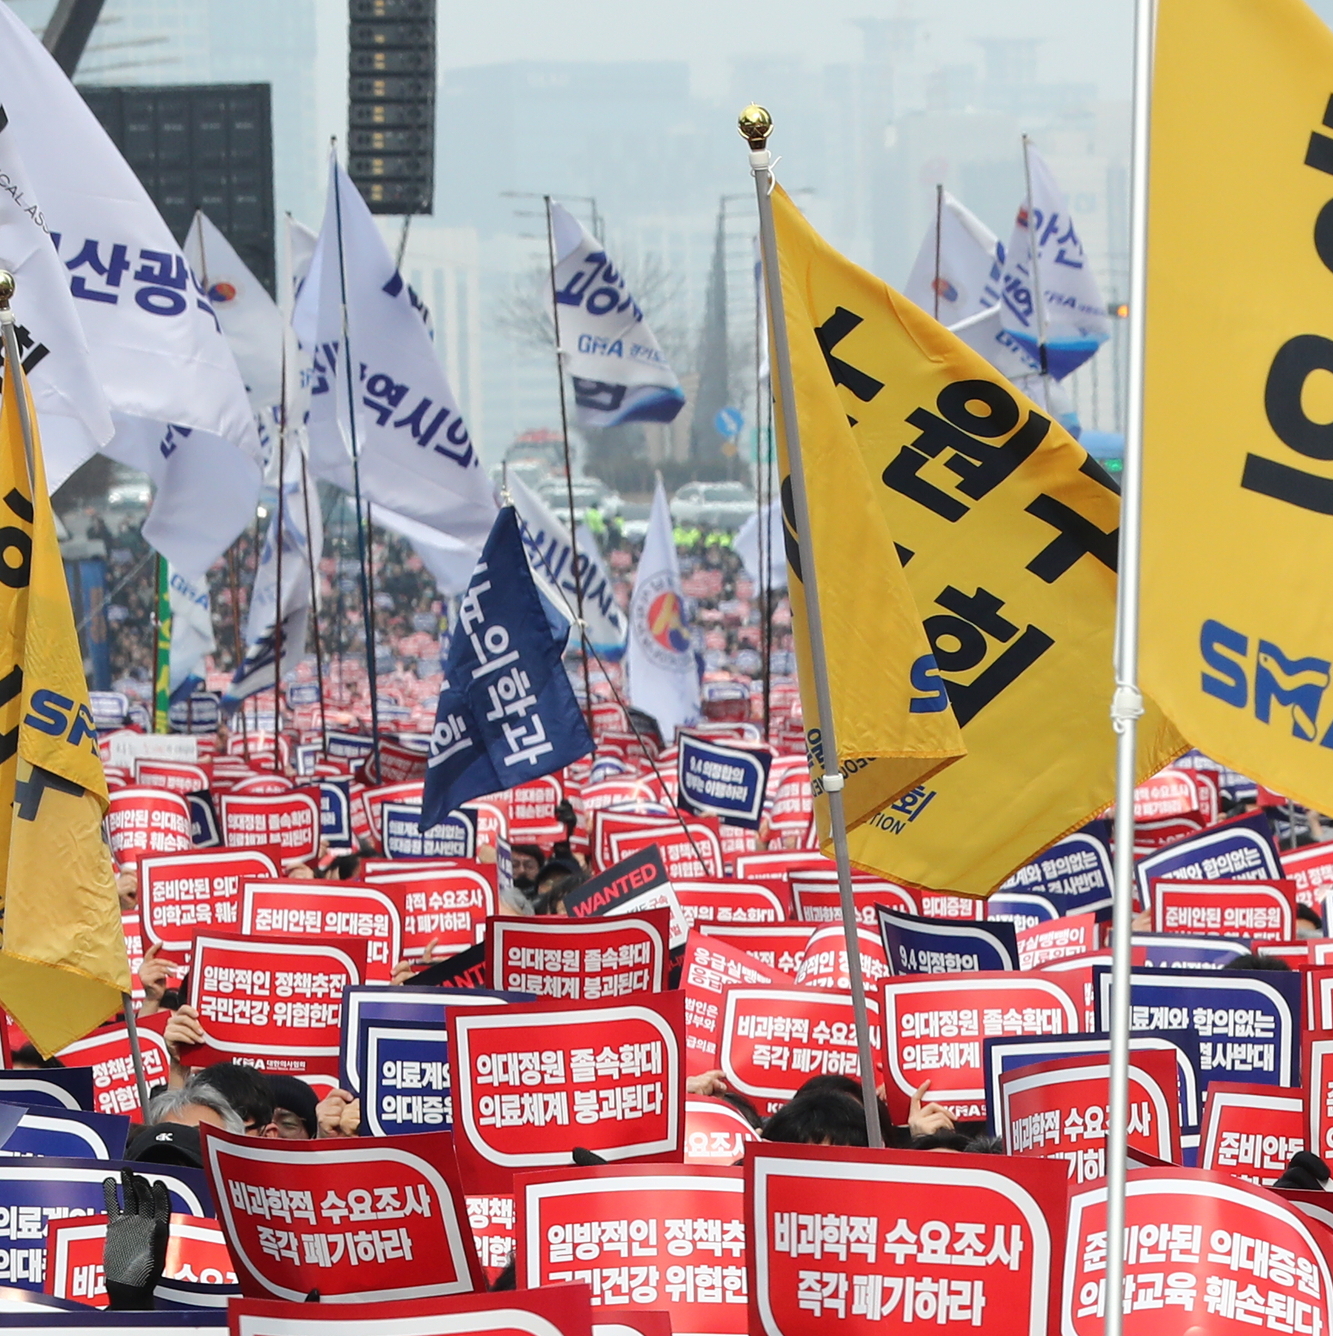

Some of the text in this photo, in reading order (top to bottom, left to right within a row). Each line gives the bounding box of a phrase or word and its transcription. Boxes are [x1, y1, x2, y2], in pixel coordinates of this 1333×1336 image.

[704, 759, 745, 784] 의정합의
[1042, 851, 1097, 881] 합의없는
[1203, 847, 1261, 879] 합의없는
[153, 878, 211, 901] 준비안된
[429, 889, 483, 910] 수요조사
[573, 862, 657, 918] WANTED
[153, 905, 211, 926] 의학교육
[922, 896, 973, 917] 의대증원
[1165, 906, 1281, 928] 준비안된 의대증원
[257, 908, 389, 937] 준비안된 의대증원
[508, 941, 650, 972] 의대정원 졸속확대
[918, 953, 979, 972] 의정합의
[205, 966, 346, 999] 일방적인 정책추진
[508, 973, 580, 998] 의료체계
[584, 970, 649, 998] 붕괴된다
[202, 1002, 270, 1026] 국민건강
[902, 1007, 1061, 1038] 의대정원 졸속확대
[1193, 1008, 1275, 1038] 합의없는
[738, 1014, 809, 1045] 비과학적
[233, 1057, 266, 1071] KMA
[477, 1041, 662, 1087] 의대정원 졸속확대
[752, 1045, 788, 1070] 즉각
[902, 1042, 980, 1071] 의료체계
[480, 1083, 663, 1128] 의료체계 붕괴된다
[1012, 1115, 1060, 1152] 비과학적
[228, 1178, 432, 1226] 비과학적 수요조사
[258, 1225, 414, 1268] 즉각 폐기하라
[548, 1222, 658, 1264] 일방적인
[774, 1211, 1024, 1271] 비과학적 수요조사
[1207, 1228, 1320, 1300] 의대증원
[798, 1271, 986, 1326] 즉각 폐기하라
